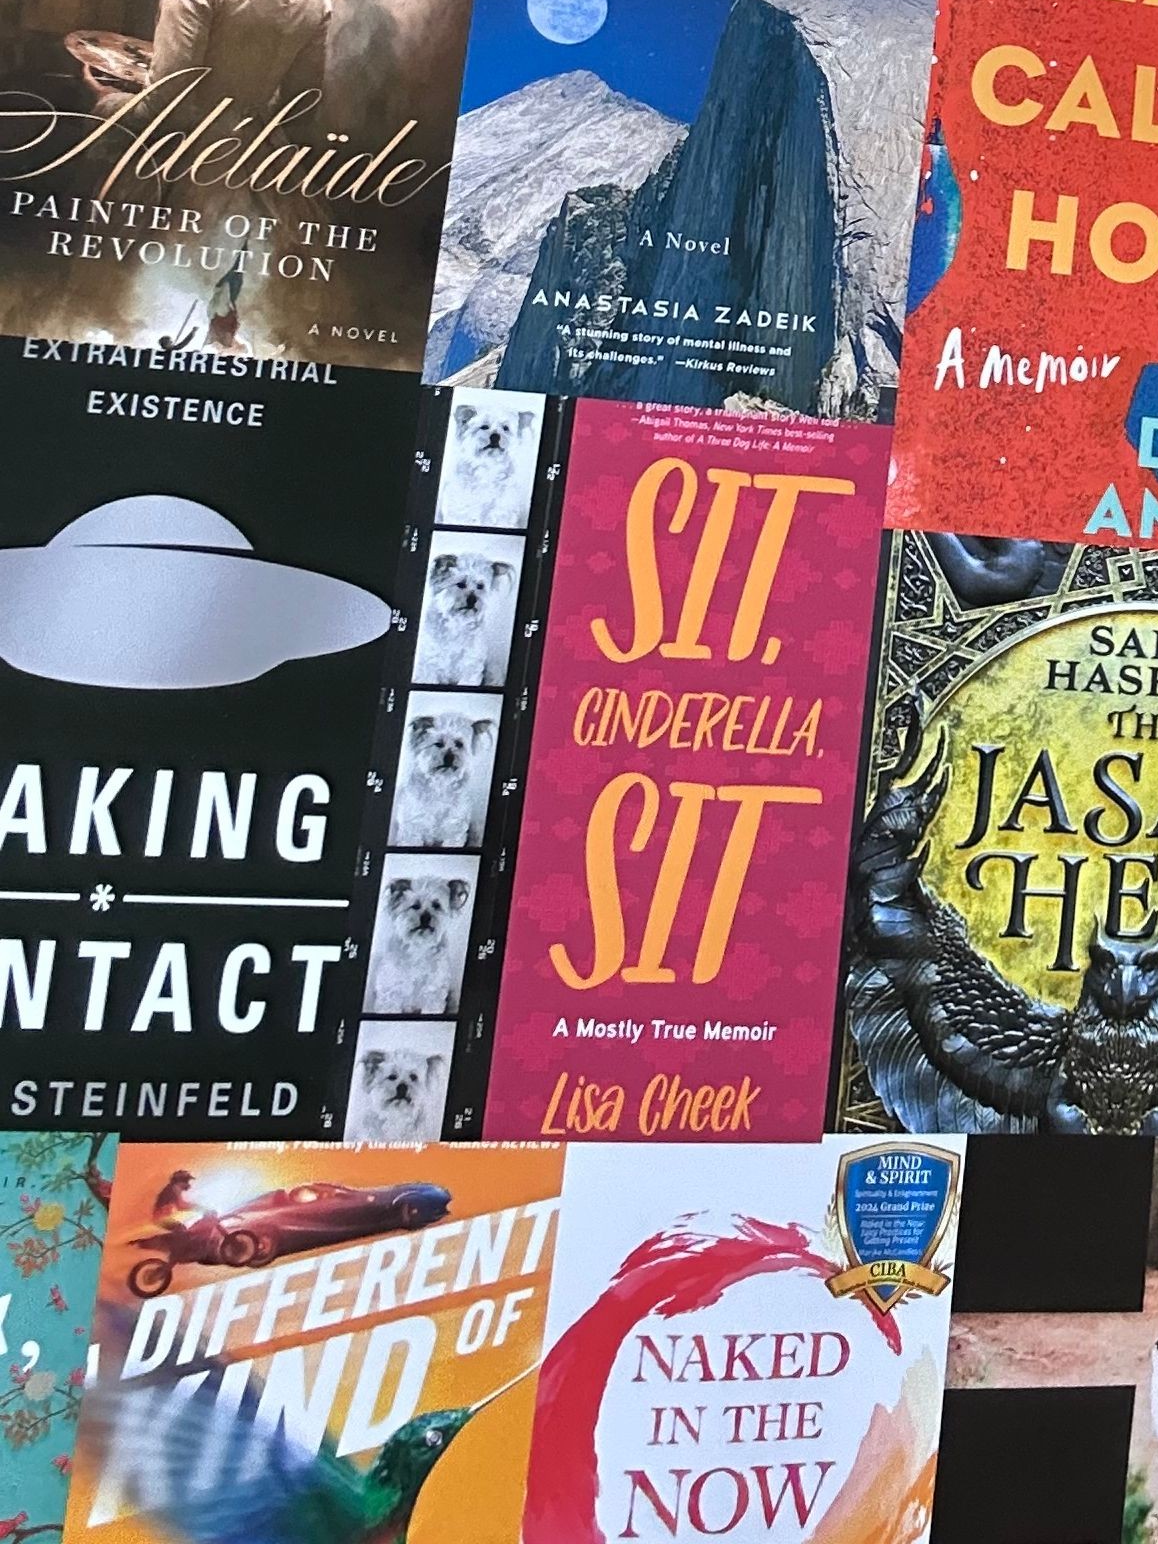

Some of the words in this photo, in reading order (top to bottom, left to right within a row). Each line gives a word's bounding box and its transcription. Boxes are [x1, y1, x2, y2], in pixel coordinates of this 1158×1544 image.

[9, 191, 205, 235] PAINTER
[224, 212, 281, 243] OF
[299, 220, 380, 254] THE
[640, 229, 654, 248] A
[665, 230, 732, 257] Novel
[47, 229, 336, 284] REVOLUTION
[332, 325, 400, 346] NOVEL
[531, 287, 701, 323] ANASTASIA
[713, 305, 819, 334] ZADEIK
[22, 335, 339, 386] EXTRATERRESTRIAL
[575, 325, 629, 344] stunning
[683, 335, 726, 350] mental
[934, 326, 966, 392] A
[87, 389, 266, 428] EXISTENCE
[590, 455, 857, 666] SIT,
[549, 770, 824, 991] SIT
[552, 1017, 569, 1039] A
[576, 1017, 645, 1045] Mostly
[651, 1019, 697, 1041] True
[703, 1020, 778, 1042] Memoir
[10, 1079, 300, 1119] STEINFELD
[541, 1071, 626, 1136] Lisa
[638, 1071, 763, 1137] Cheek
[877, 1155, 923, 1171] MIND
[878, 1169, 932, 1185] SPIRIT
[120, 1194, 563, 1382] DIFFERENT
[455, 1286, 535, 1358] OF
[631, 1330, 852, 1384] NAKED
[646, 1406, 708, 1446] IN
[722, 1401, 826, 1444] THE
[617, 1460, 837, 1540] NOW
